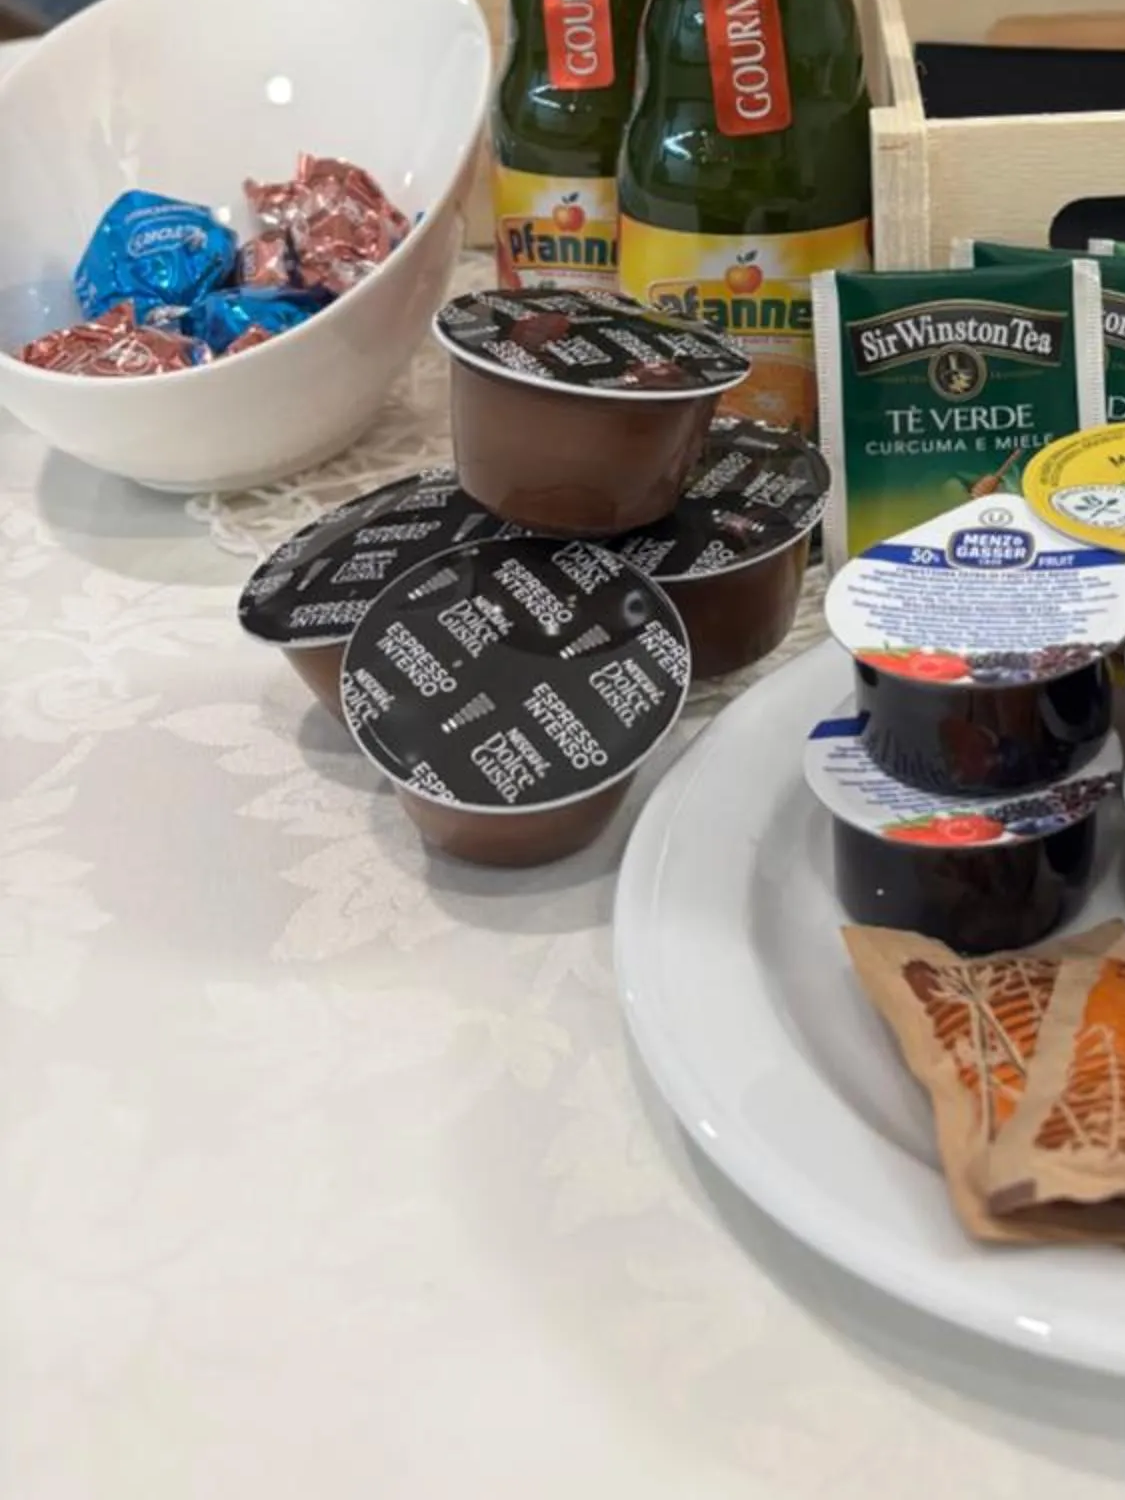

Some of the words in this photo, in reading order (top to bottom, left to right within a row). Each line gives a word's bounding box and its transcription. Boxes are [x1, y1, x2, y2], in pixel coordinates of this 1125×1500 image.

[653, 285, 813, 329] pfanne
[860, 329, 898, 363] Sir
[893, 315, 1009, 347] Winston
[1009, 317, 1053, 355] Tea
[885, 404, 924, 435] TÈ
[929, 403, 1035, 432] VERDE
[864, 439, 968, 457] CURCUMA
[975, 436, 987, 452] E
[955, 546, 1027, 561] GASSER
[501, 558, 574, 624] ESPRESSO
[376, 634, 438, 698] INTENSO
[385, 620, 458, 693] ESPRESSO
[636, 633, 687, 686] INTENS
[645, 619, 690, 664] ESPRE
[522, 695, 590, 770] INTENSO
[532, 682, 609, 767] ESPRESSO
[486, 732, 536, 792] Dolce
